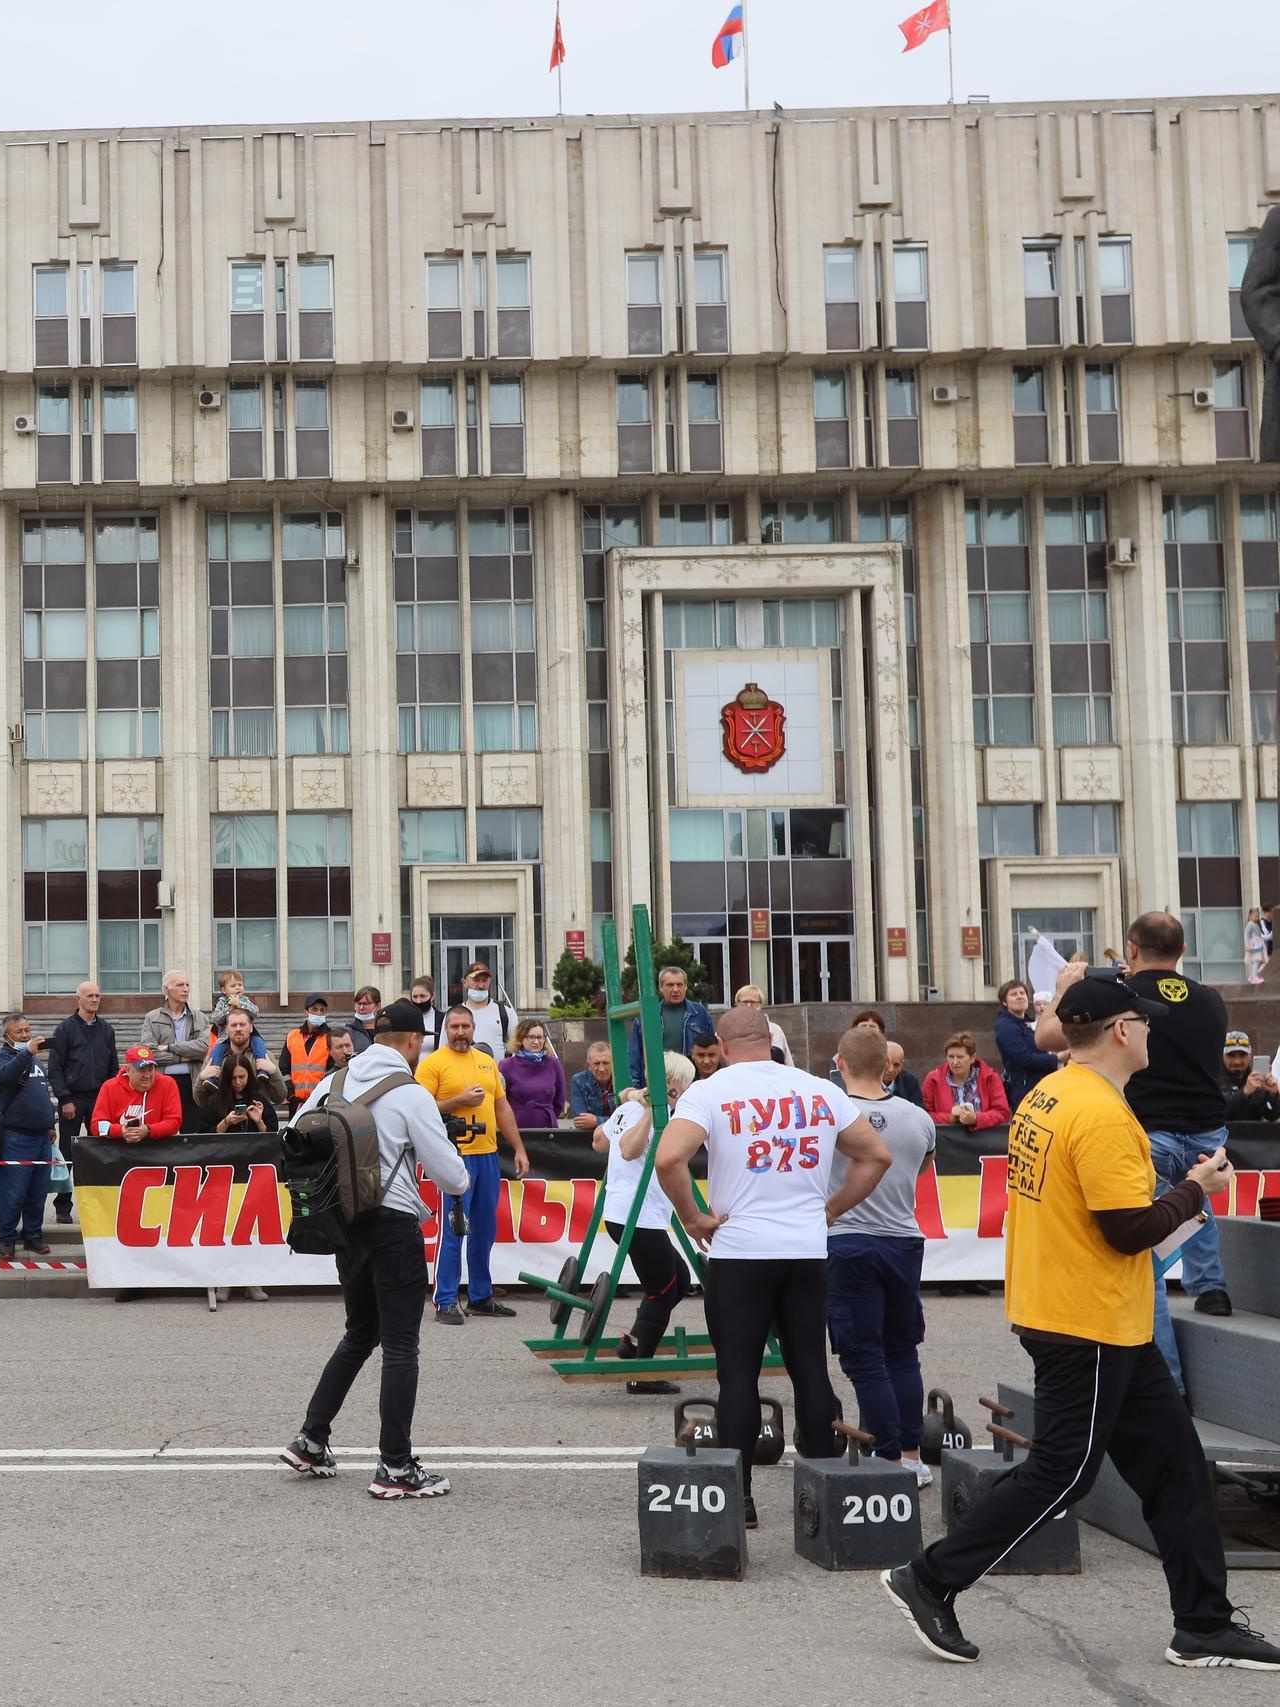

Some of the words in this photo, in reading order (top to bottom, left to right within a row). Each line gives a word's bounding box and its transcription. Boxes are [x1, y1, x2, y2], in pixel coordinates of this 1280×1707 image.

[720, 1089, 836, 1136] ТУЛА
[746, 1135, 821, 1174] 875
[115, 1164, 287, 1248] СИЛ
[694, 1425, 713, 1440] 24
[758, 1425, 774, 1439] 4
[942, 1433, 965, 1449] 40
[647, 1483, 726, 1513] 240
[842, 1494, 912, 1525] 200
